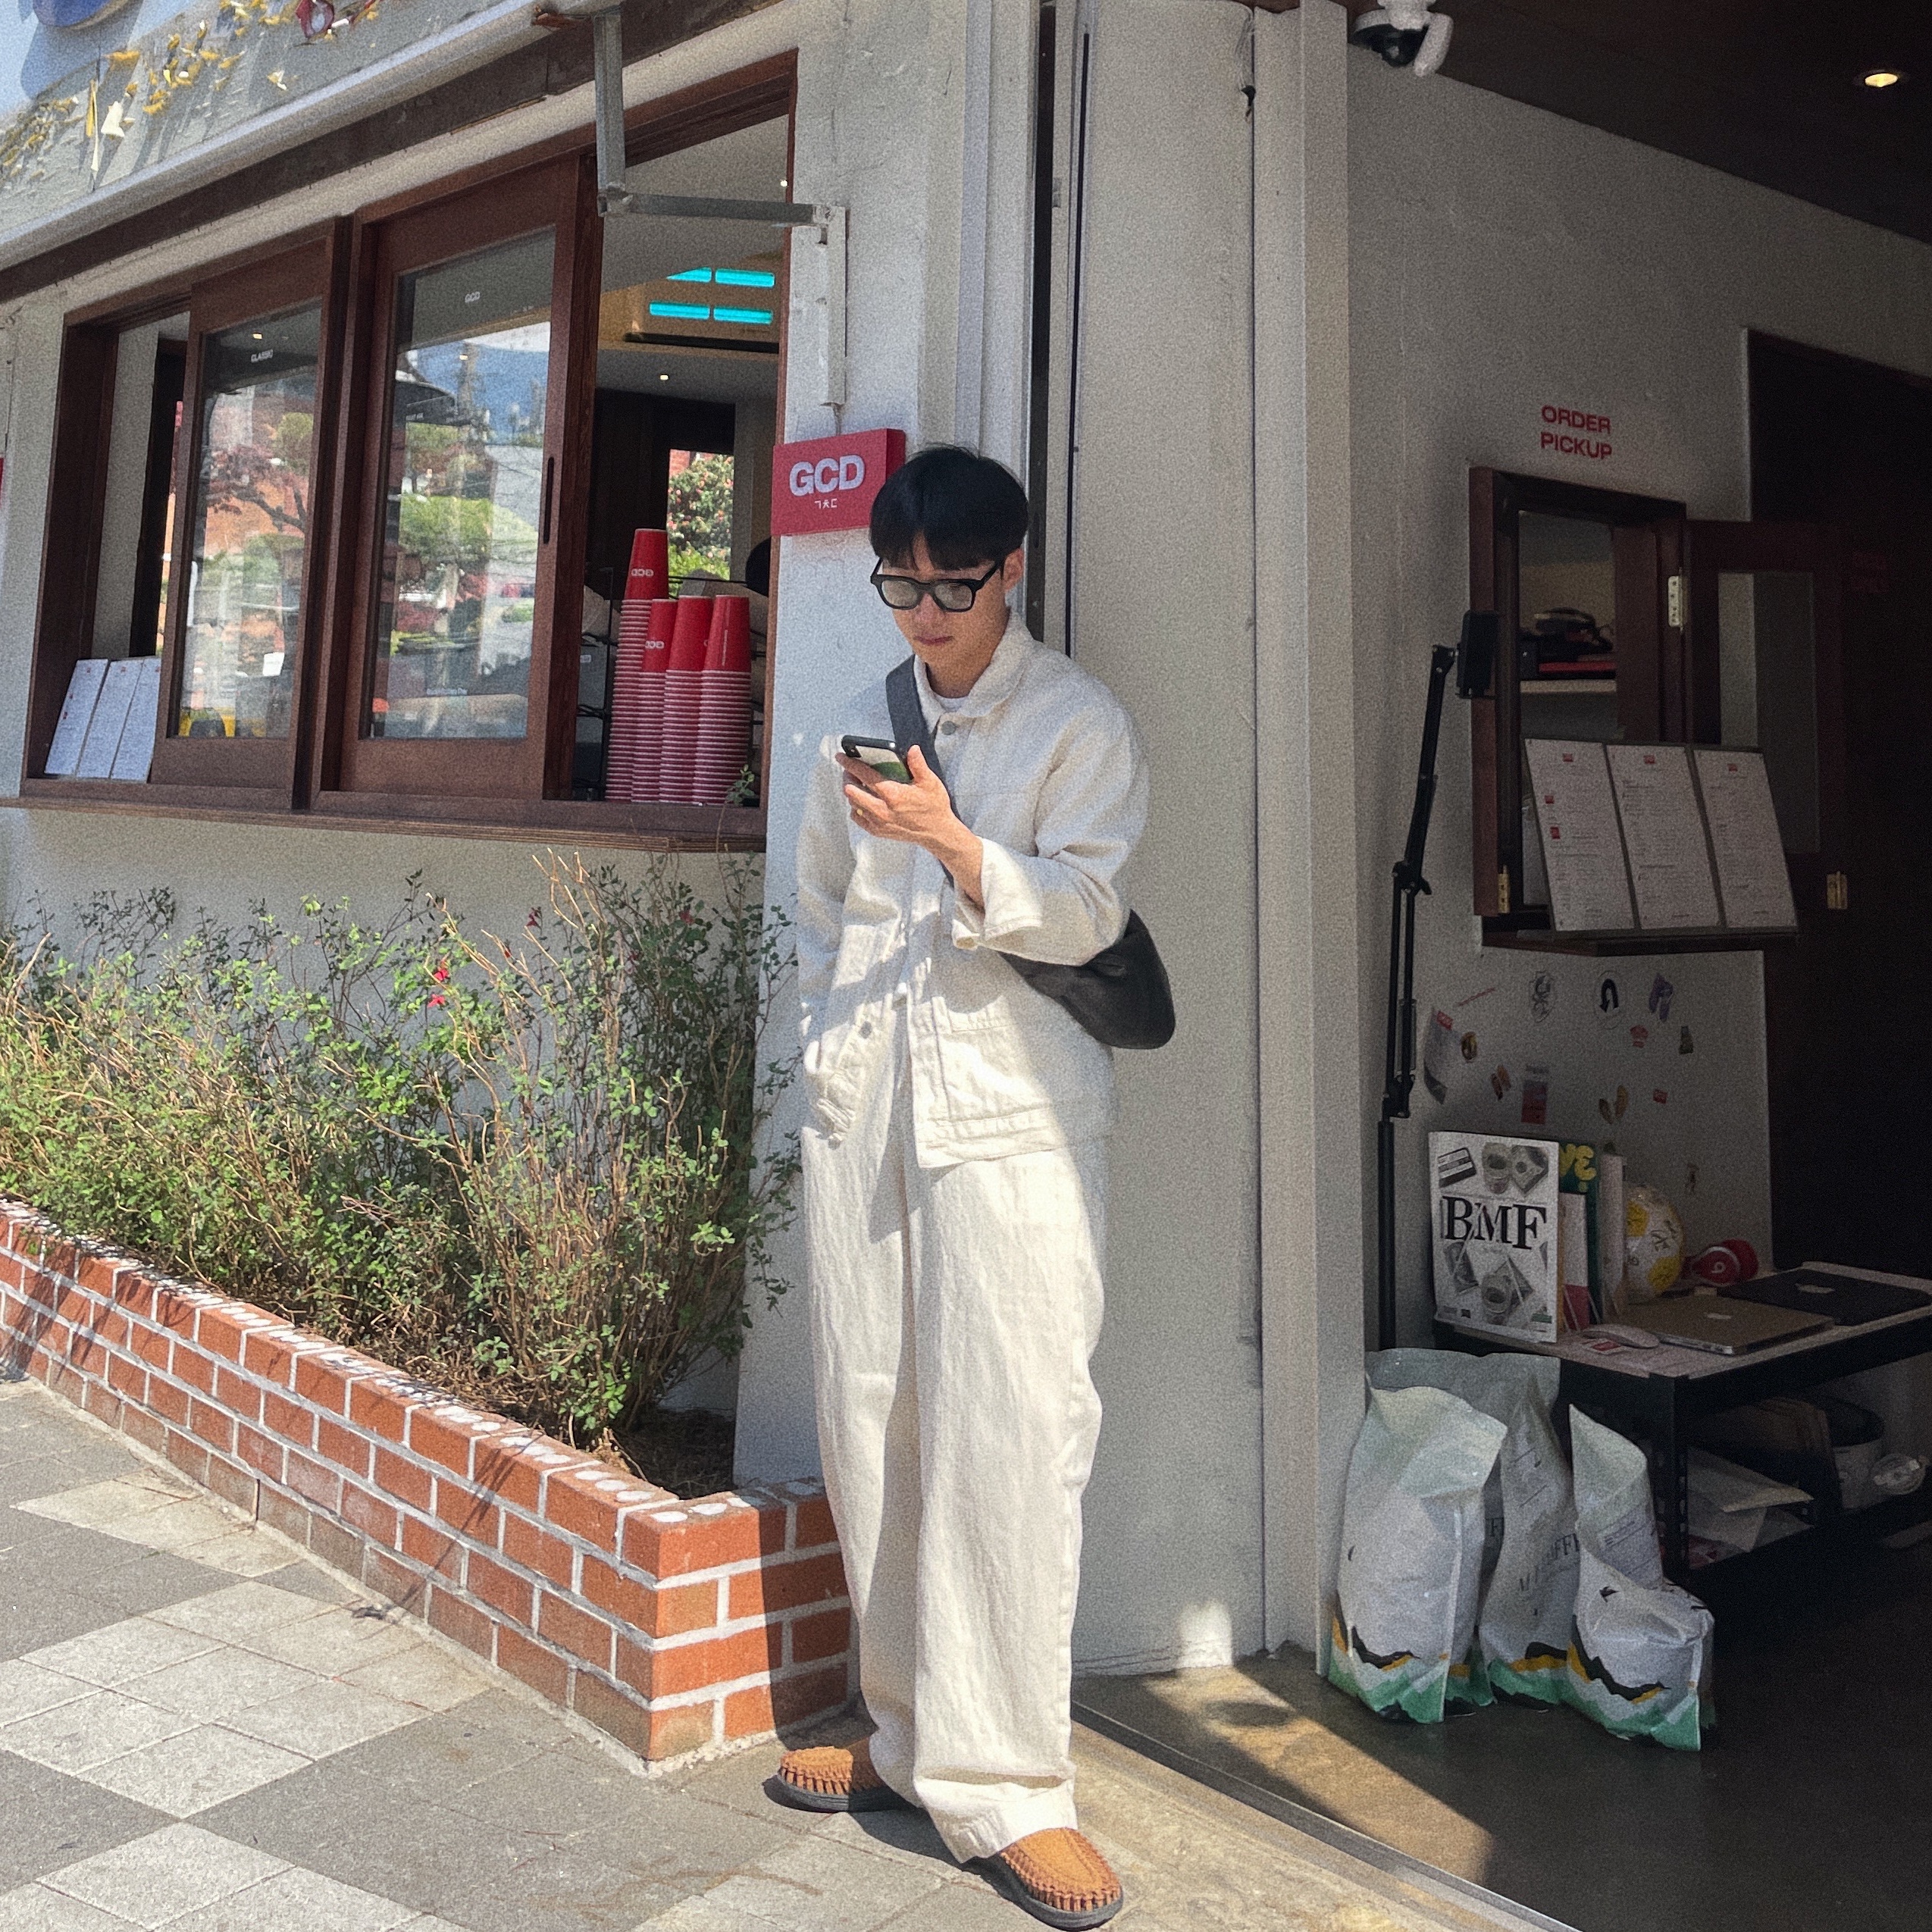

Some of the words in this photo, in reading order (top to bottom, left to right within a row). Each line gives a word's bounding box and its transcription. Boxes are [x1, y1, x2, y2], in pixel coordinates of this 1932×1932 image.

[1541, 405, 1611, 434] ORDER
[1540, 431, 1612, 459] PICKUP
[789, 454, 865, 497] GCD
[1442, 1195, 1547, 1250] BMF
